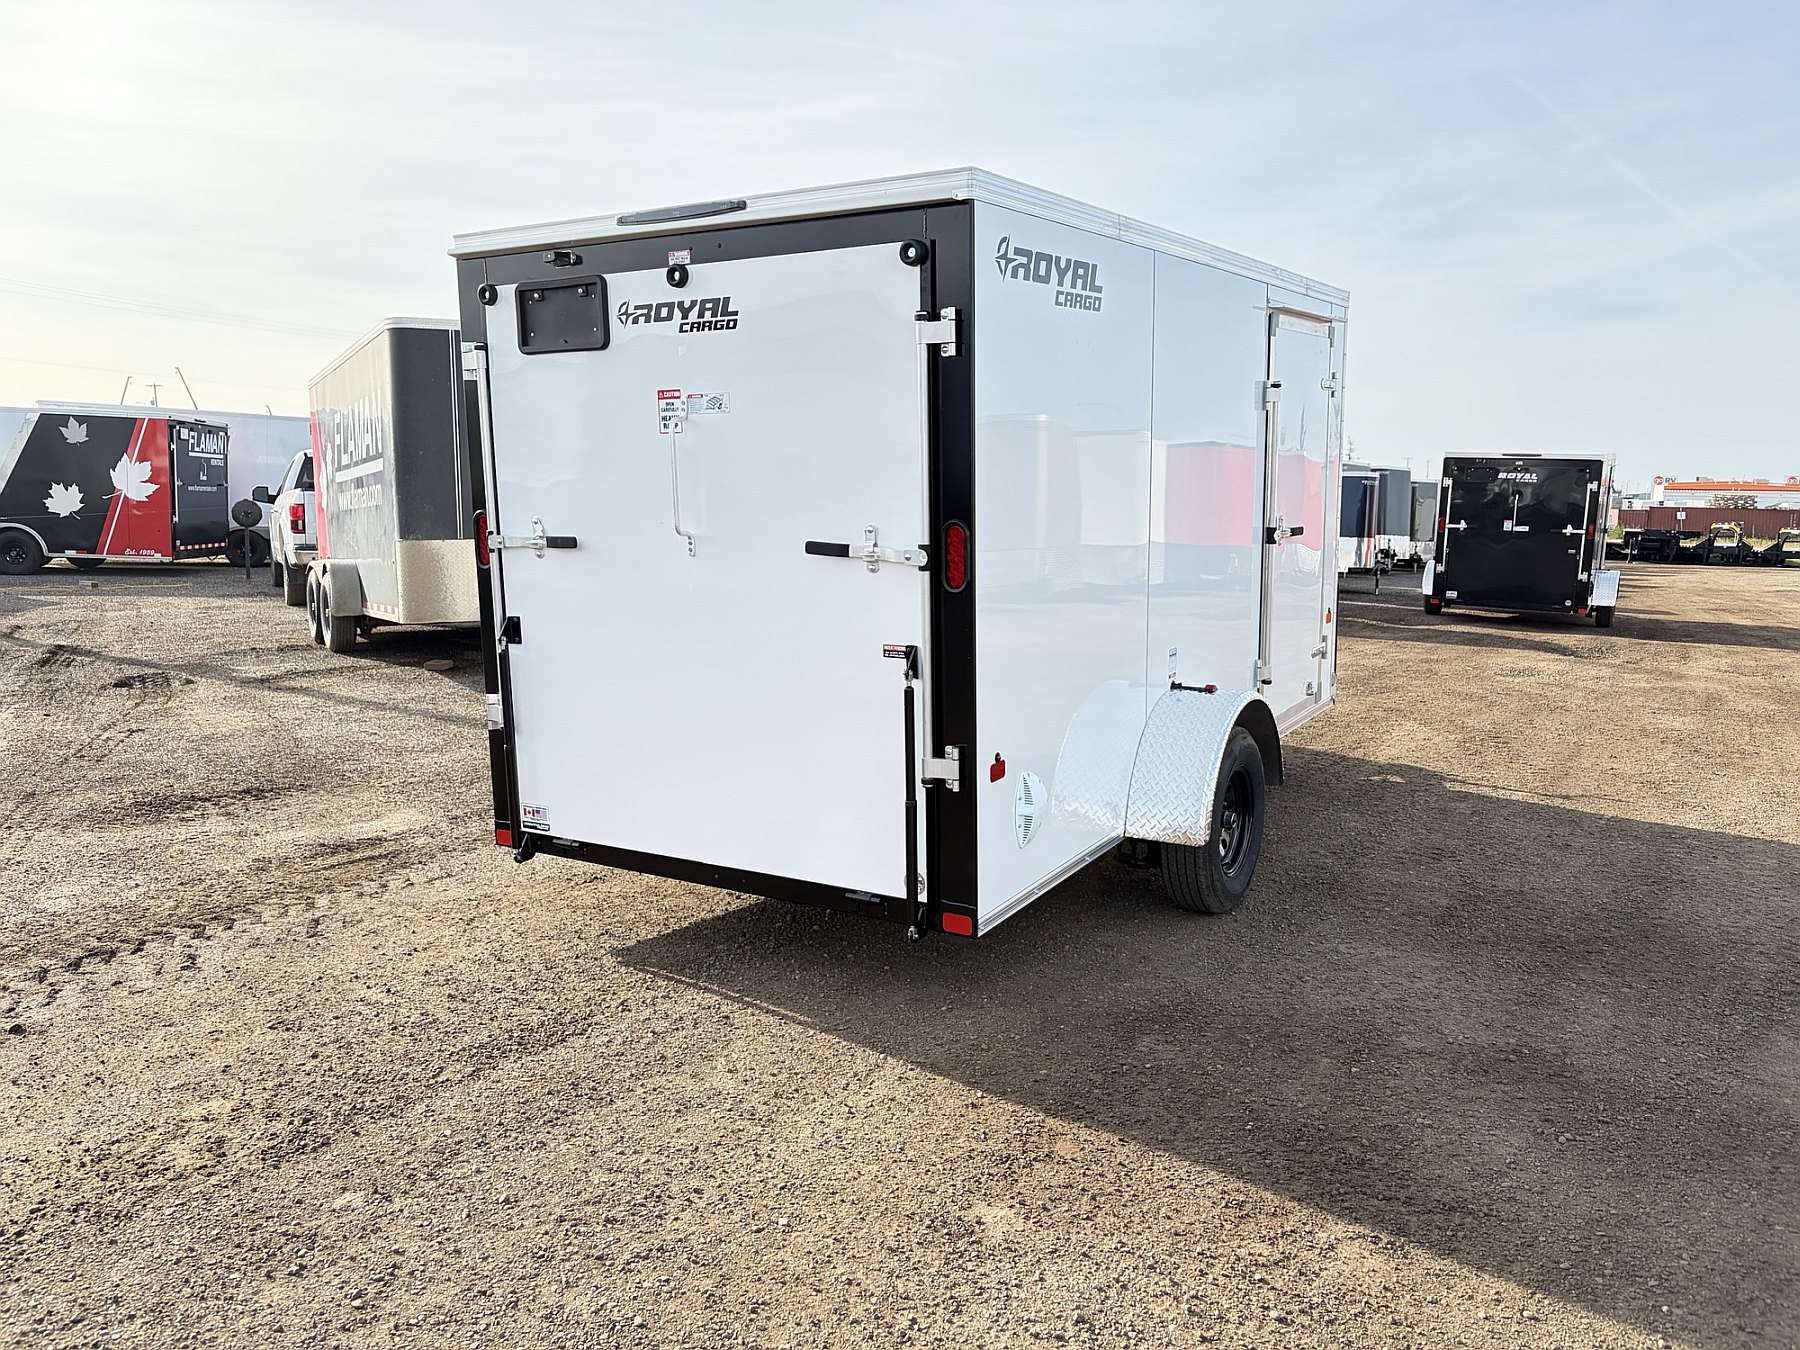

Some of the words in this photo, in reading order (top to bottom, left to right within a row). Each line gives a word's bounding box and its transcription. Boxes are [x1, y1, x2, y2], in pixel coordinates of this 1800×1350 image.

[1010, 246, 1104, 294] ROYAL
[631, 297, 739, 325] ROYAL
[1054, 289, 1103, 313] CARGO
[678, 318, 739, 334] CARGO
[334, 389, 383, 469] FLAMAN
[661, 414, 680, 422] HEA
[188, 431, 224, 454] FLAMAN
[1498, 472, 1538, 480] ROYAL
